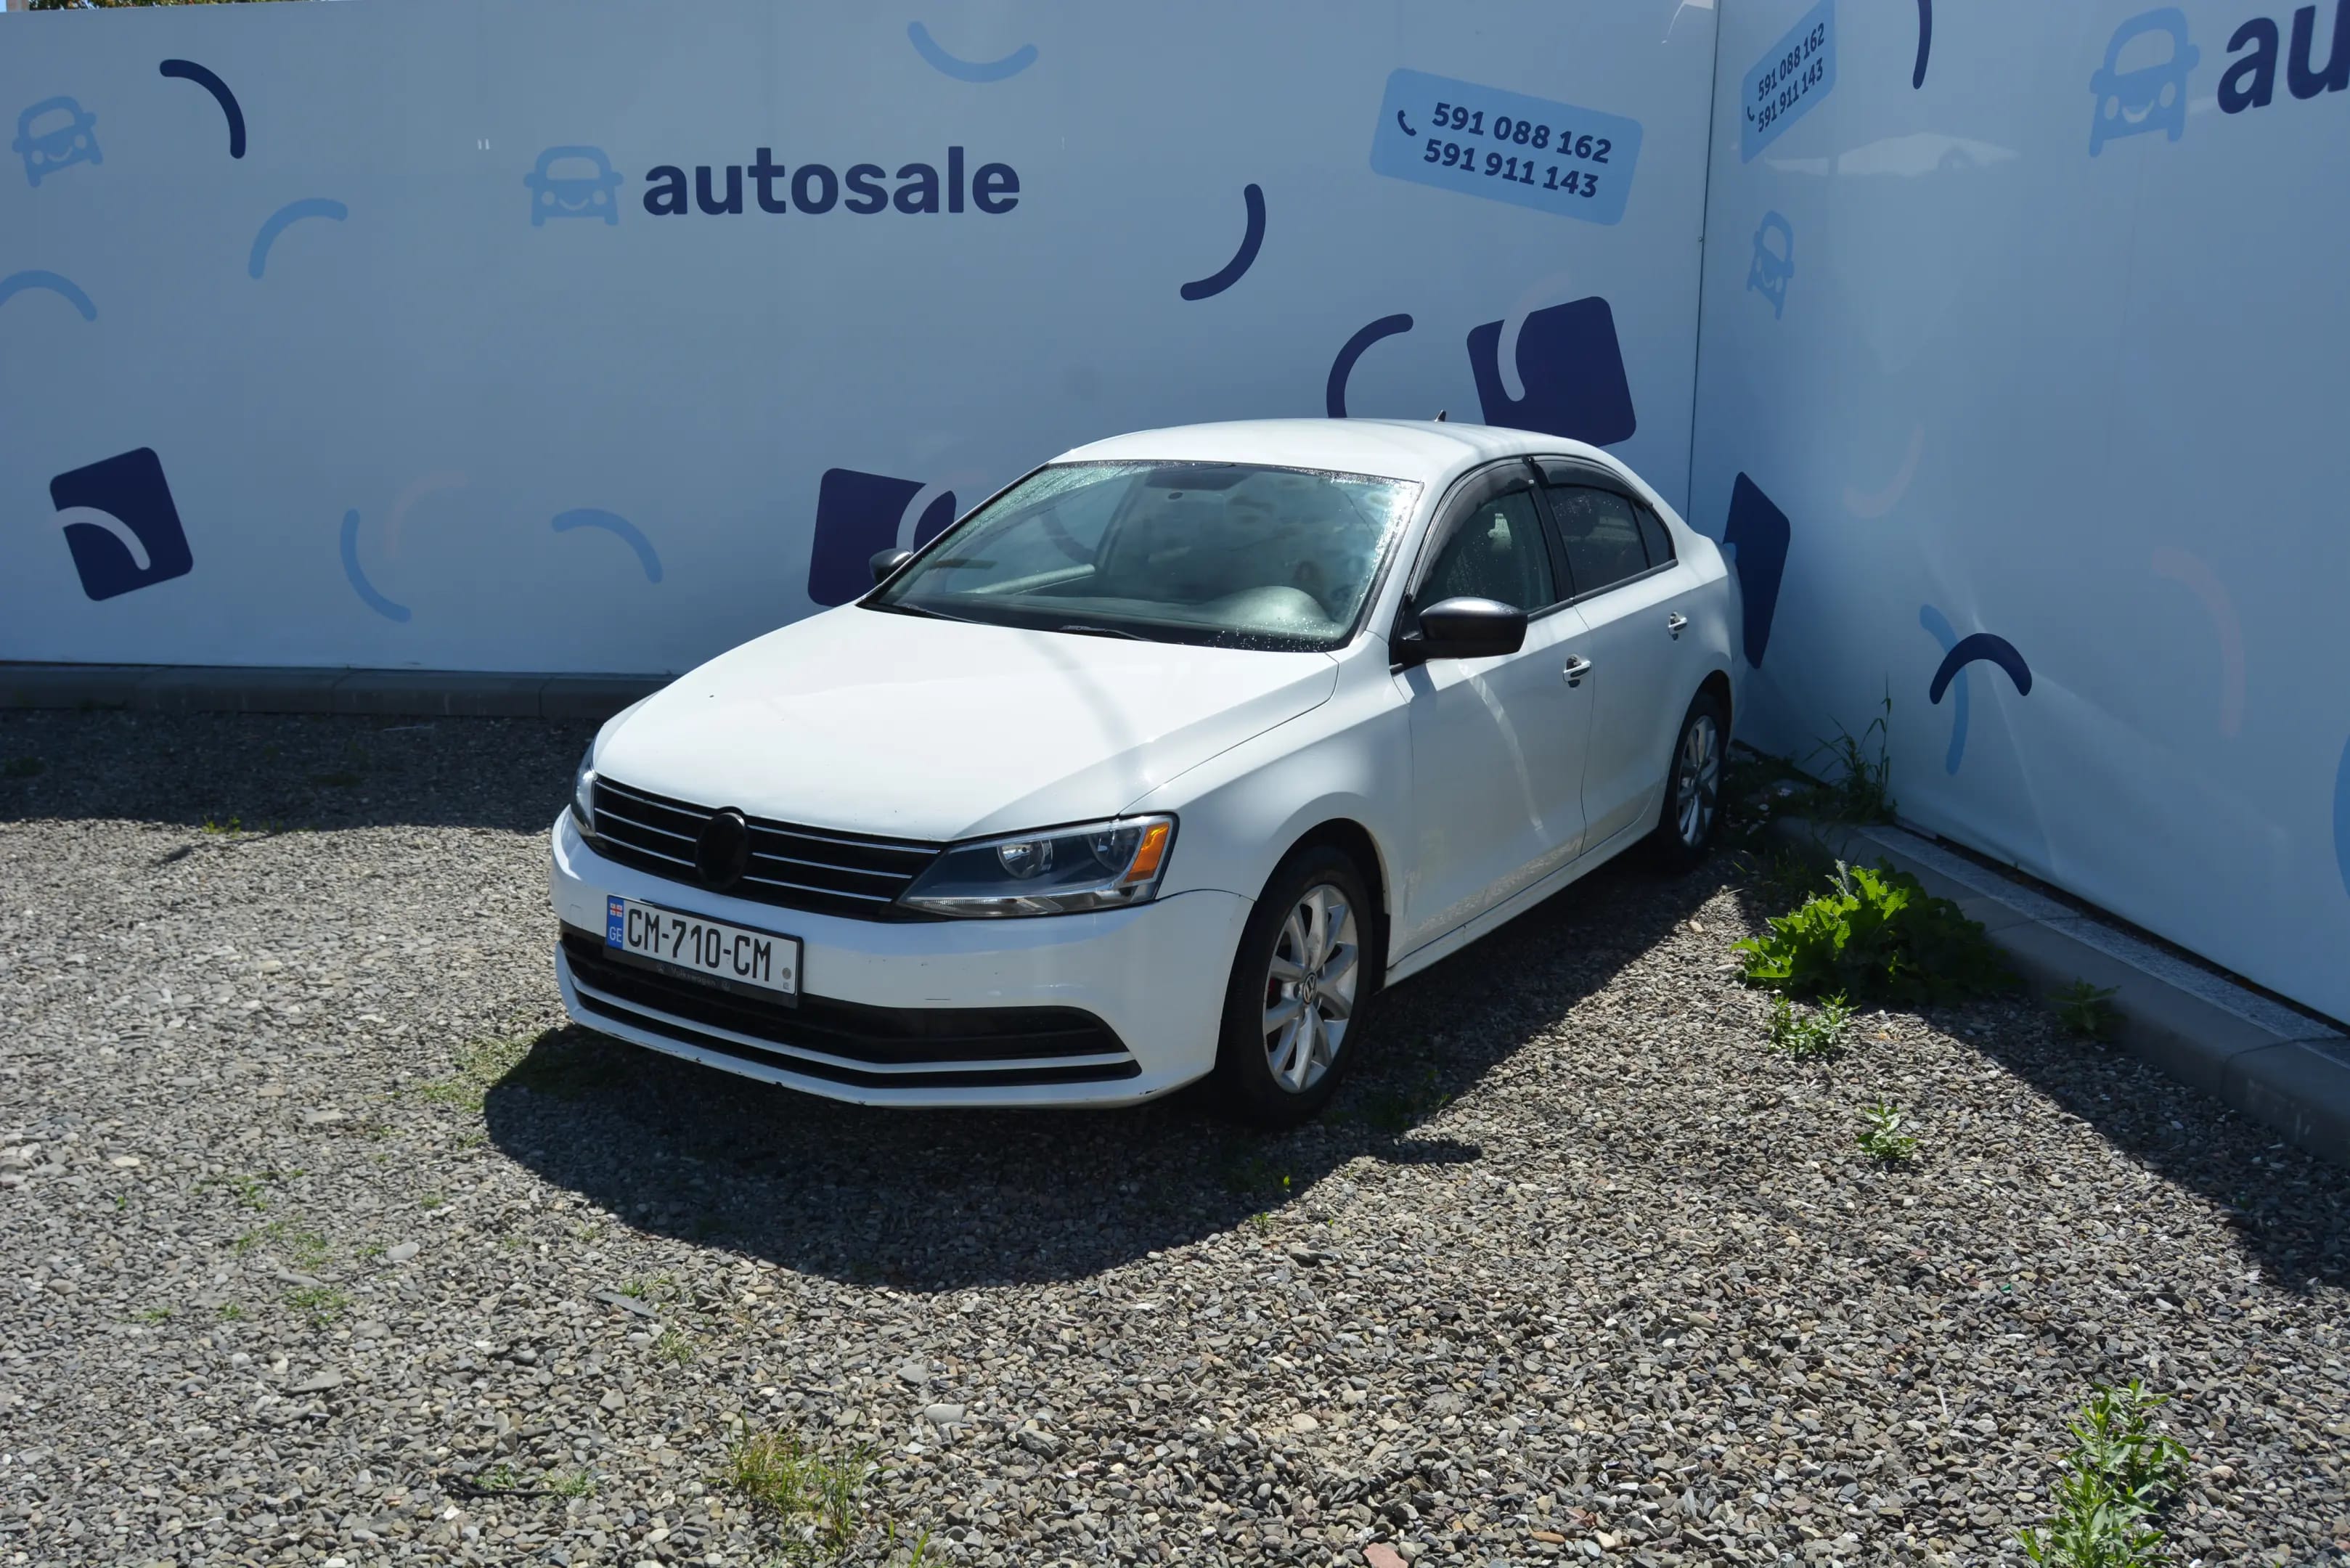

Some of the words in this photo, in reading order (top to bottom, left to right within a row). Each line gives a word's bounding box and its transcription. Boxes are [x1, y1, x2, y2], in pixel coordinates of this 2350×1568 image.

[1758, 68, 1777, 102] 591
[1779, 45, 1800, 81] 088
[1803, 23, 1824, 60] 162
[2217, 0, 2350, 114] au
[1758, 99, 1777, 133] 591
[1779, 80, 1799, 115] 911
[1802, 57, 1823, 94] 143
[1424, 138, 1476, 172] 591
[1484, 152, 1535, 185] 911
[1542, 166, 1599, 198] 143
[1432, 102, 1485, 136] 591
[1493, 115, 1551, 149] 088
[1556, 130, 1612, 164] 162
[642, 145, 1021, 216] autosale
[609, 926, 623, 944] GE
[627, 908, 772, 982] CM-710-CM
